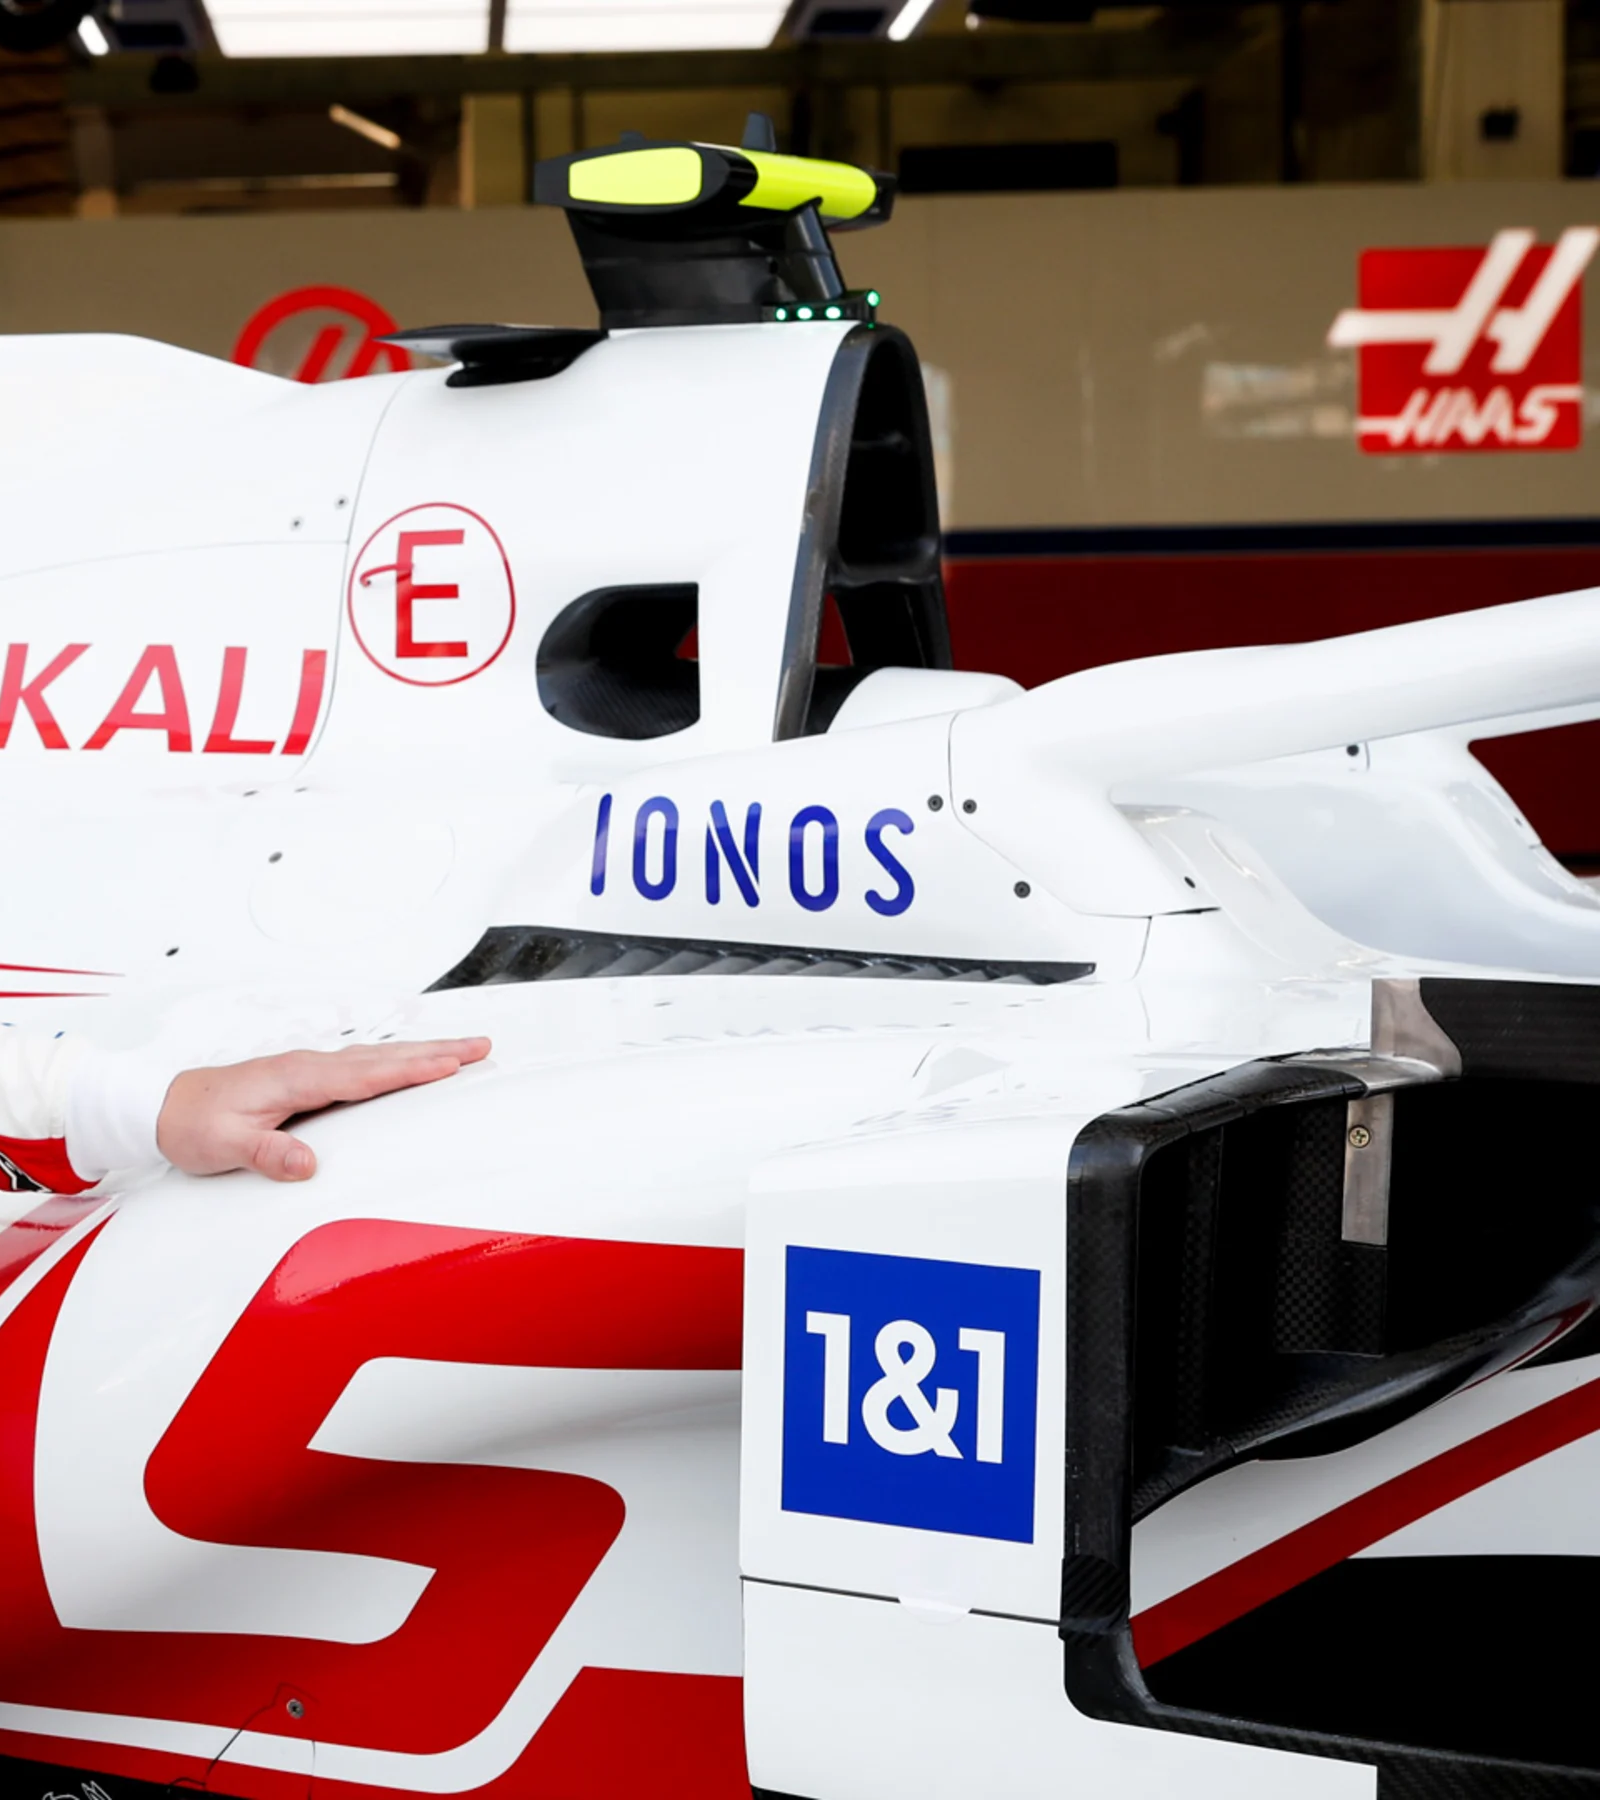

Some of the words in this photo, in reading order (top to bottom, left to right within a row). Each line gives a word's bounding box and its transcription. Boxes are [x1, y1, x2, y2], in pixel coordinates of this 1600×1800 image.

[1354, 386, 1583, 445] HAAS
[590, 793, 915, 917] IONOS
[805, 1311, 1006, 1465] 1&1
